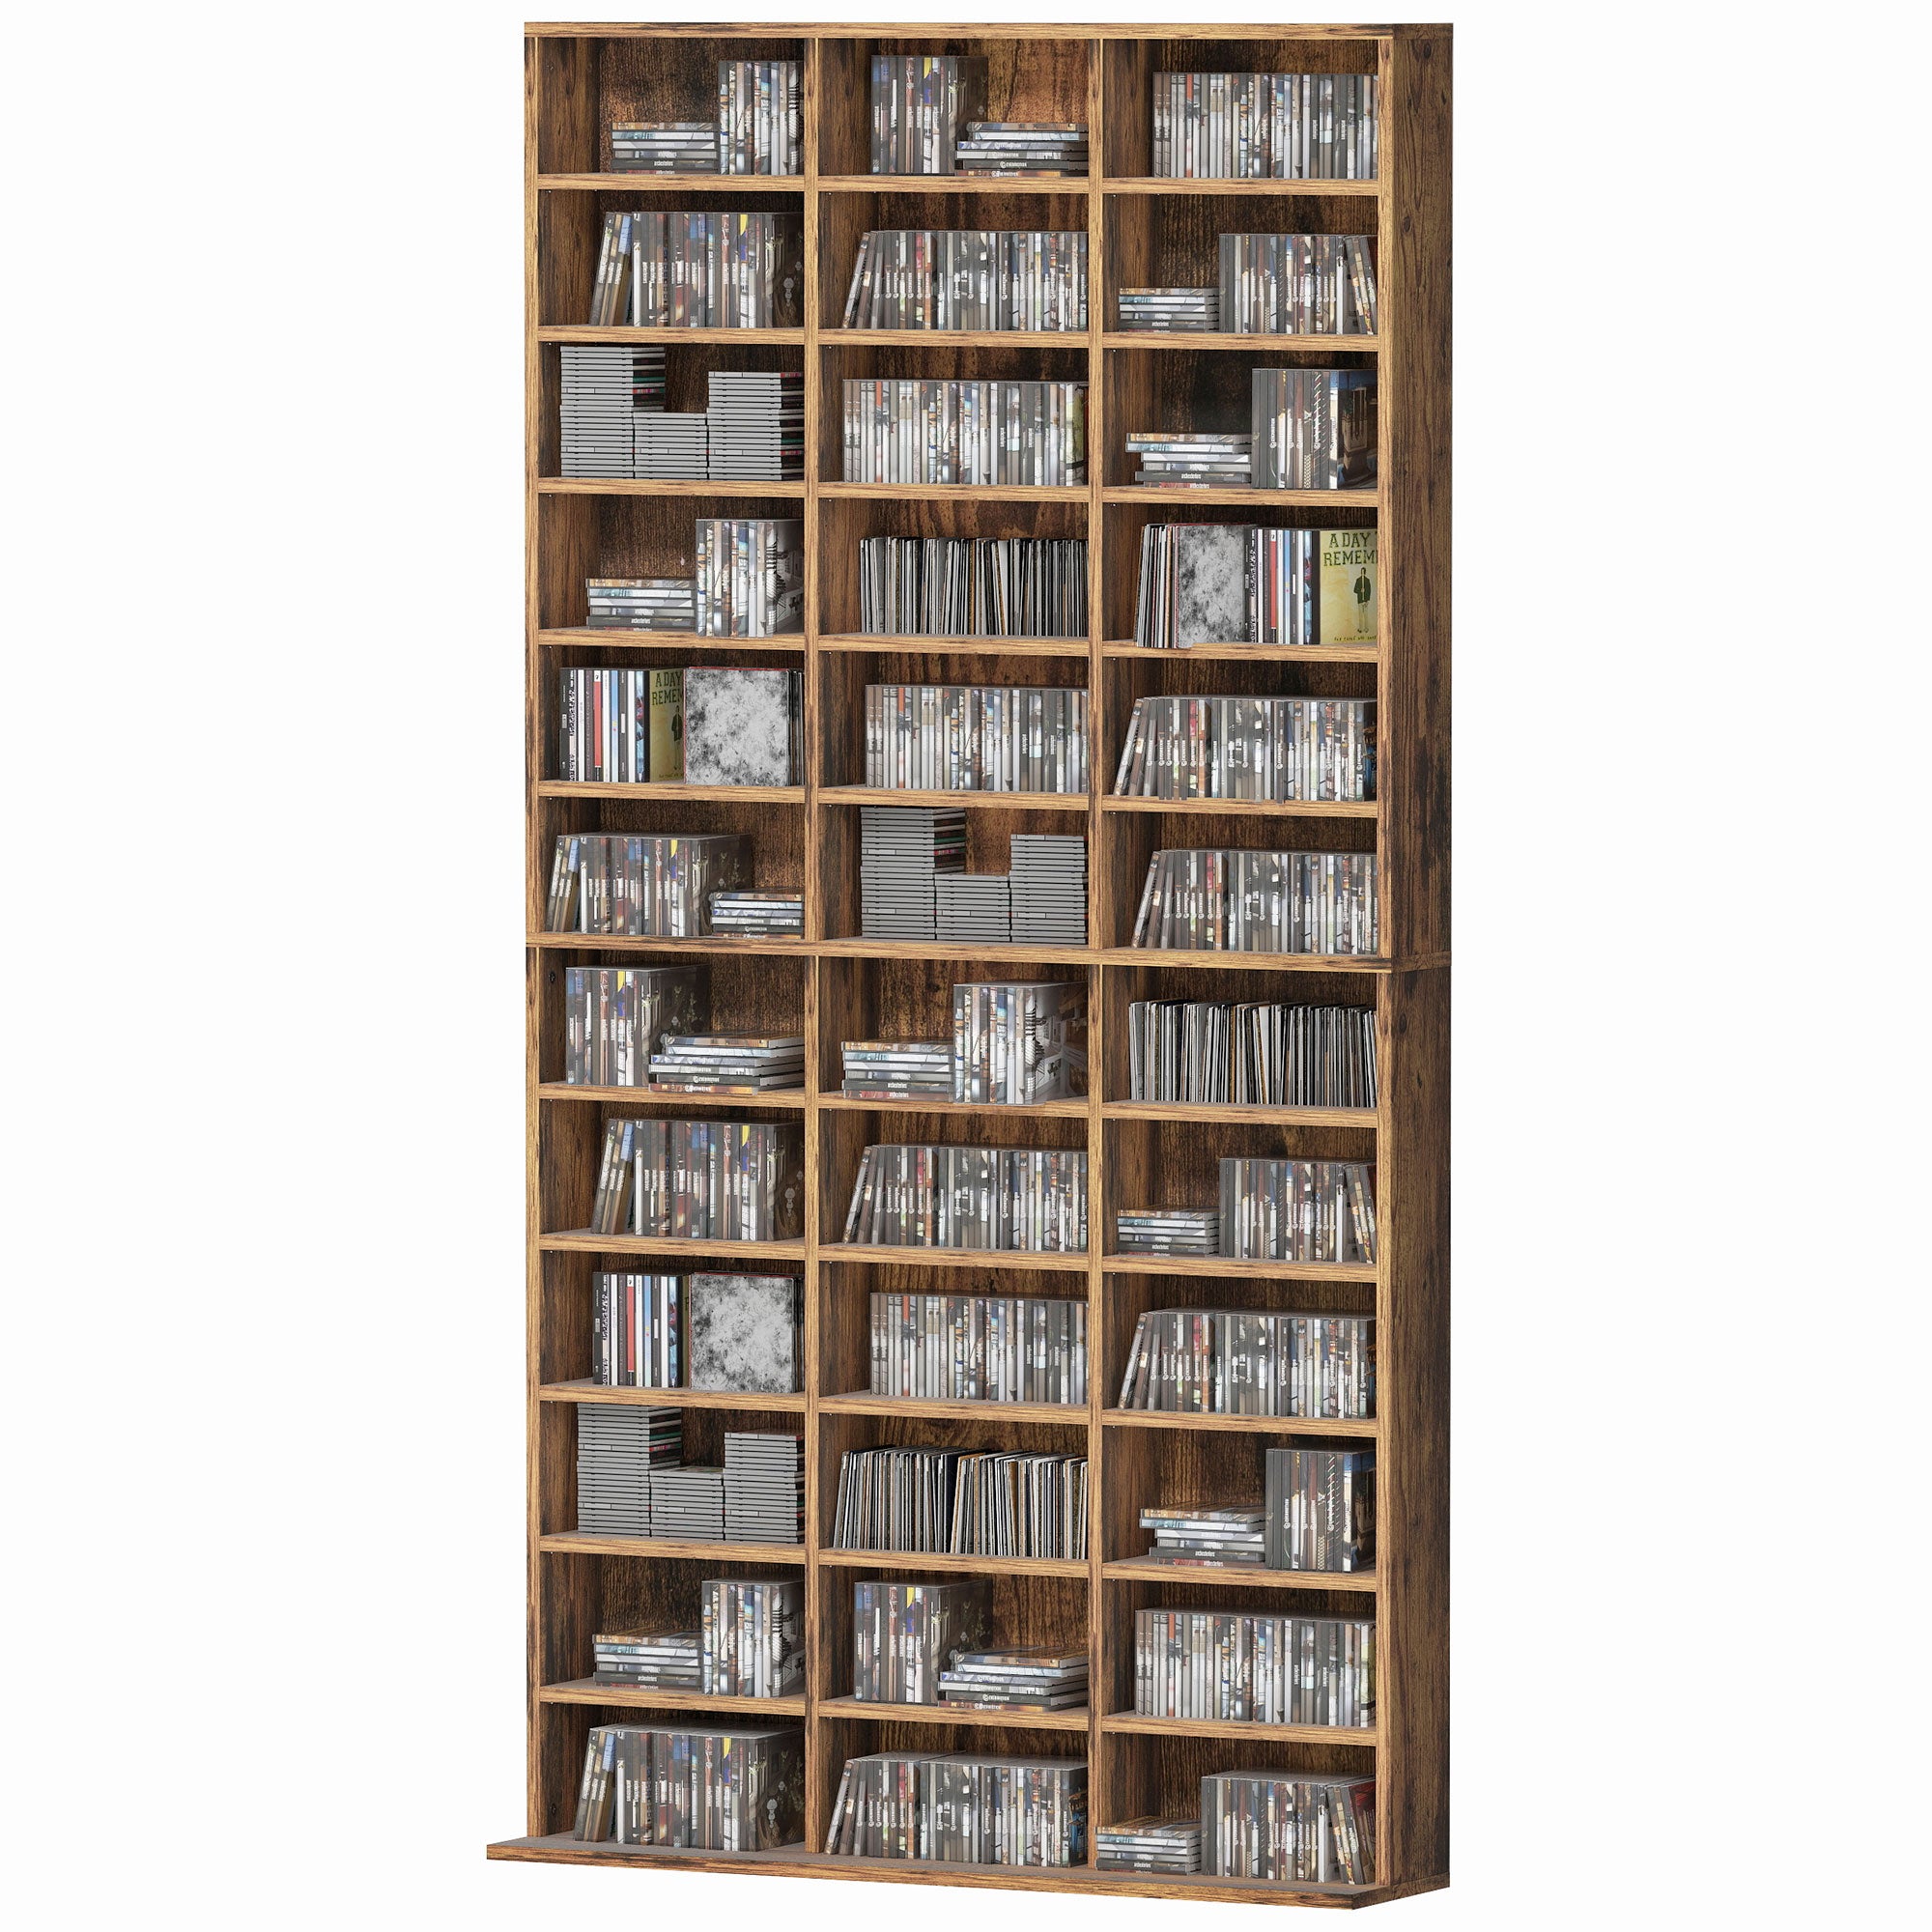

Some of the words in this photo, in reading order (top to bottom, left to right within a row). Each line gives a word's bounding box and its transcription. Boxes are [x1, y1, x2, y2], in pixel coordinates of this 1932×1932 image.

[1329, 533, 1339, 548] A
[1342, 532, 1371, 548] DAY
[1323, 550, 1378, 566] REMEM
[655, 672, 662, 687] A
[664, 671, 682, 687] DAY
